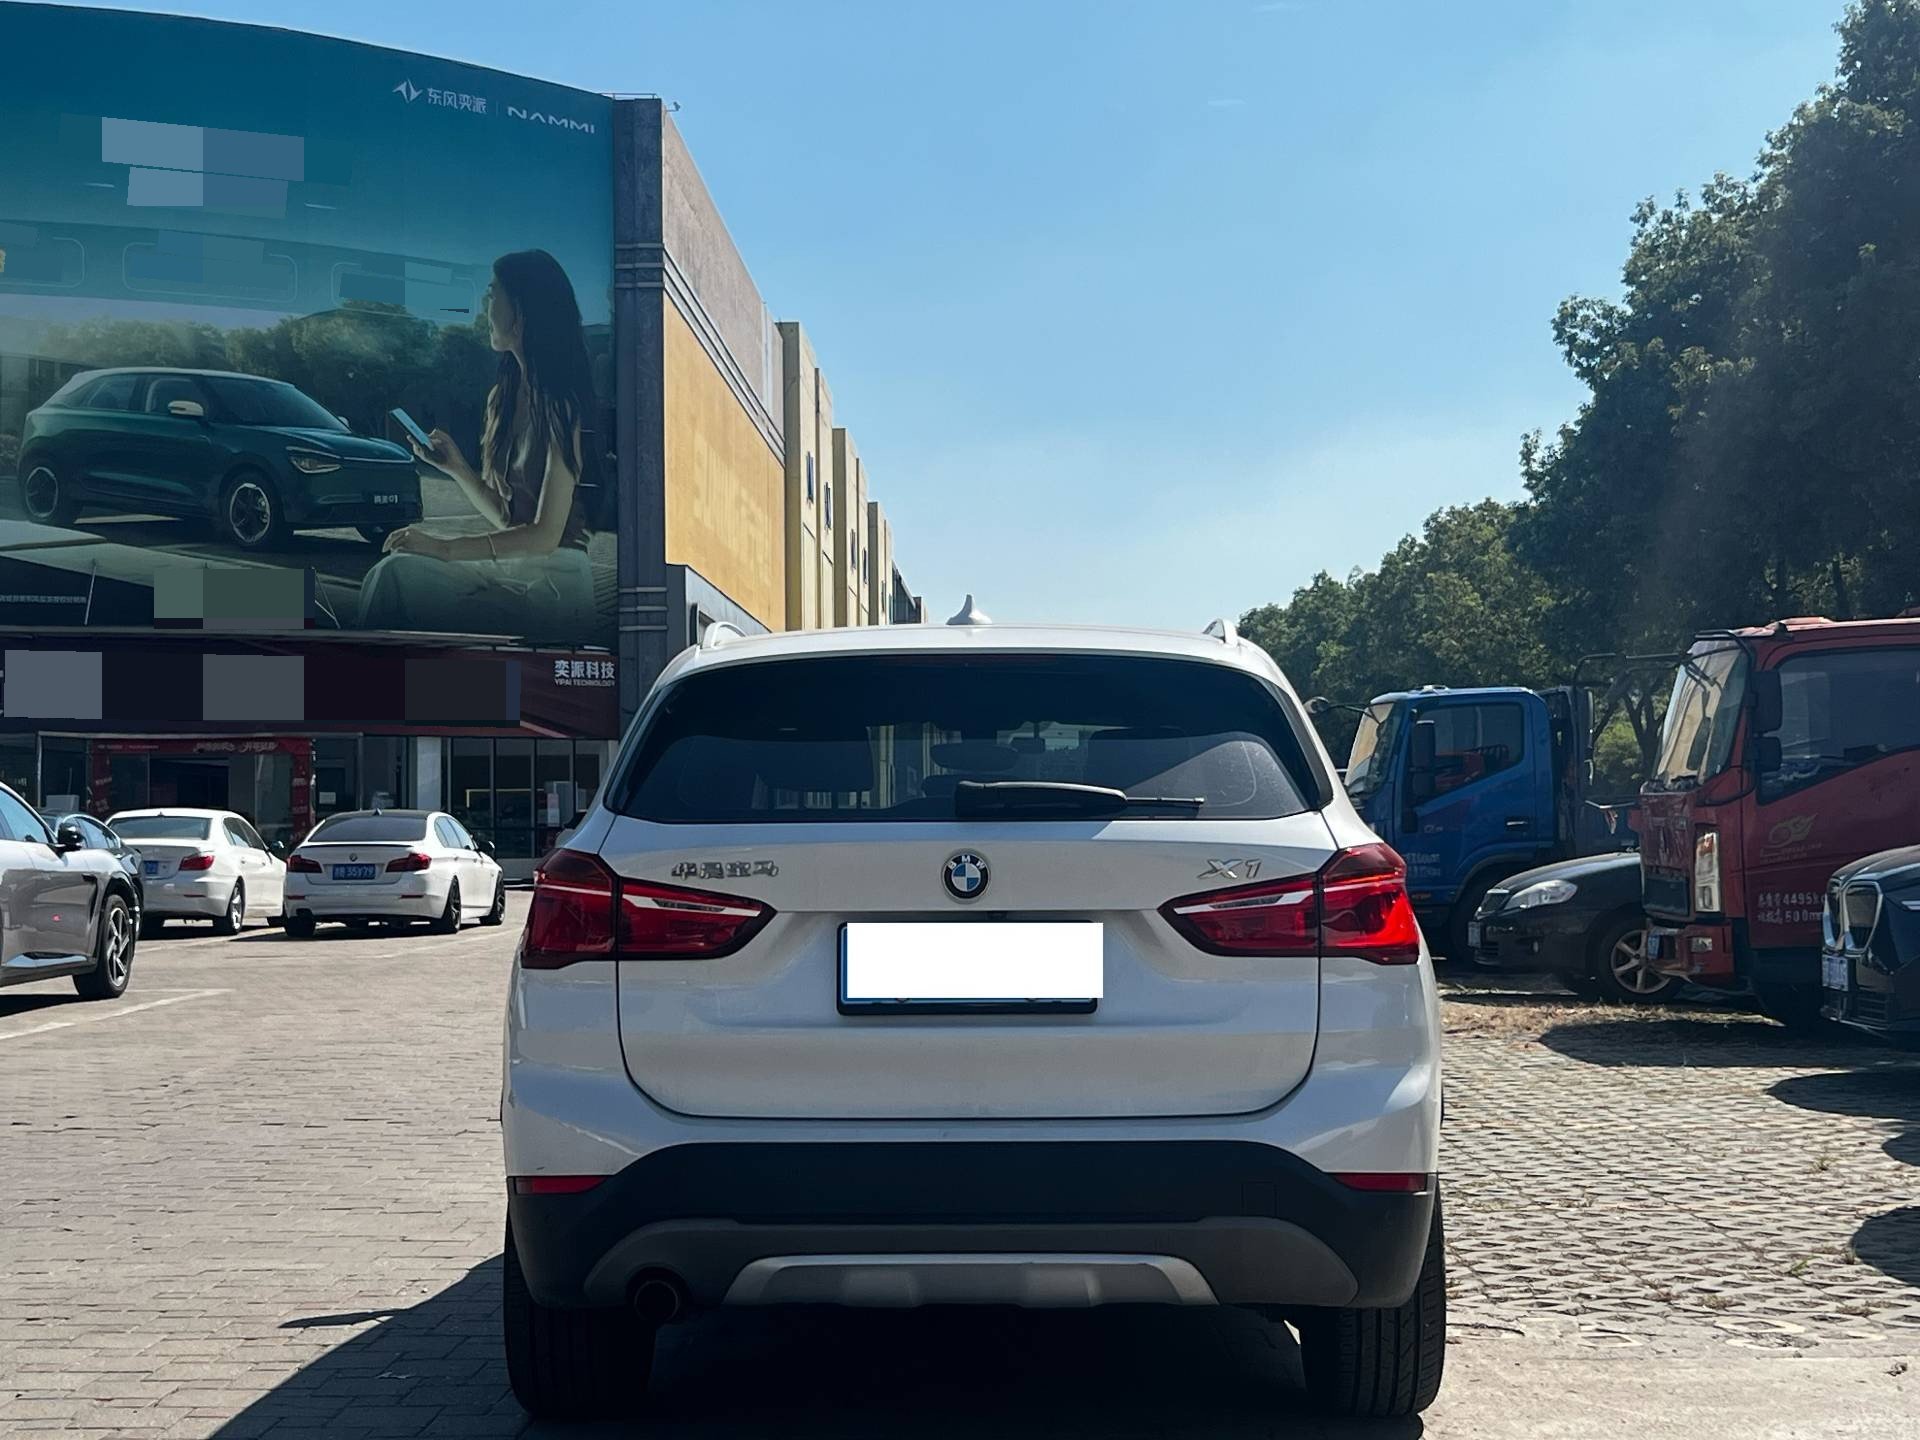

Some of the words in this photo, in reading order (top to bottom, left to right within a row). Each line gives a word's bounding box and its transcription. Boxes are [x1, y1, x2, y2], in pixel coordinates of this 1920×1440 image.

[427, 87, 489, 115] 东风奕派
[507, 106, 596, 134] NAMMI
[554, 660, 616, 679] 奕派科技
[671, 861, 779, 880] 华晨宝马
[1197, 859, 1262, 879] X1
